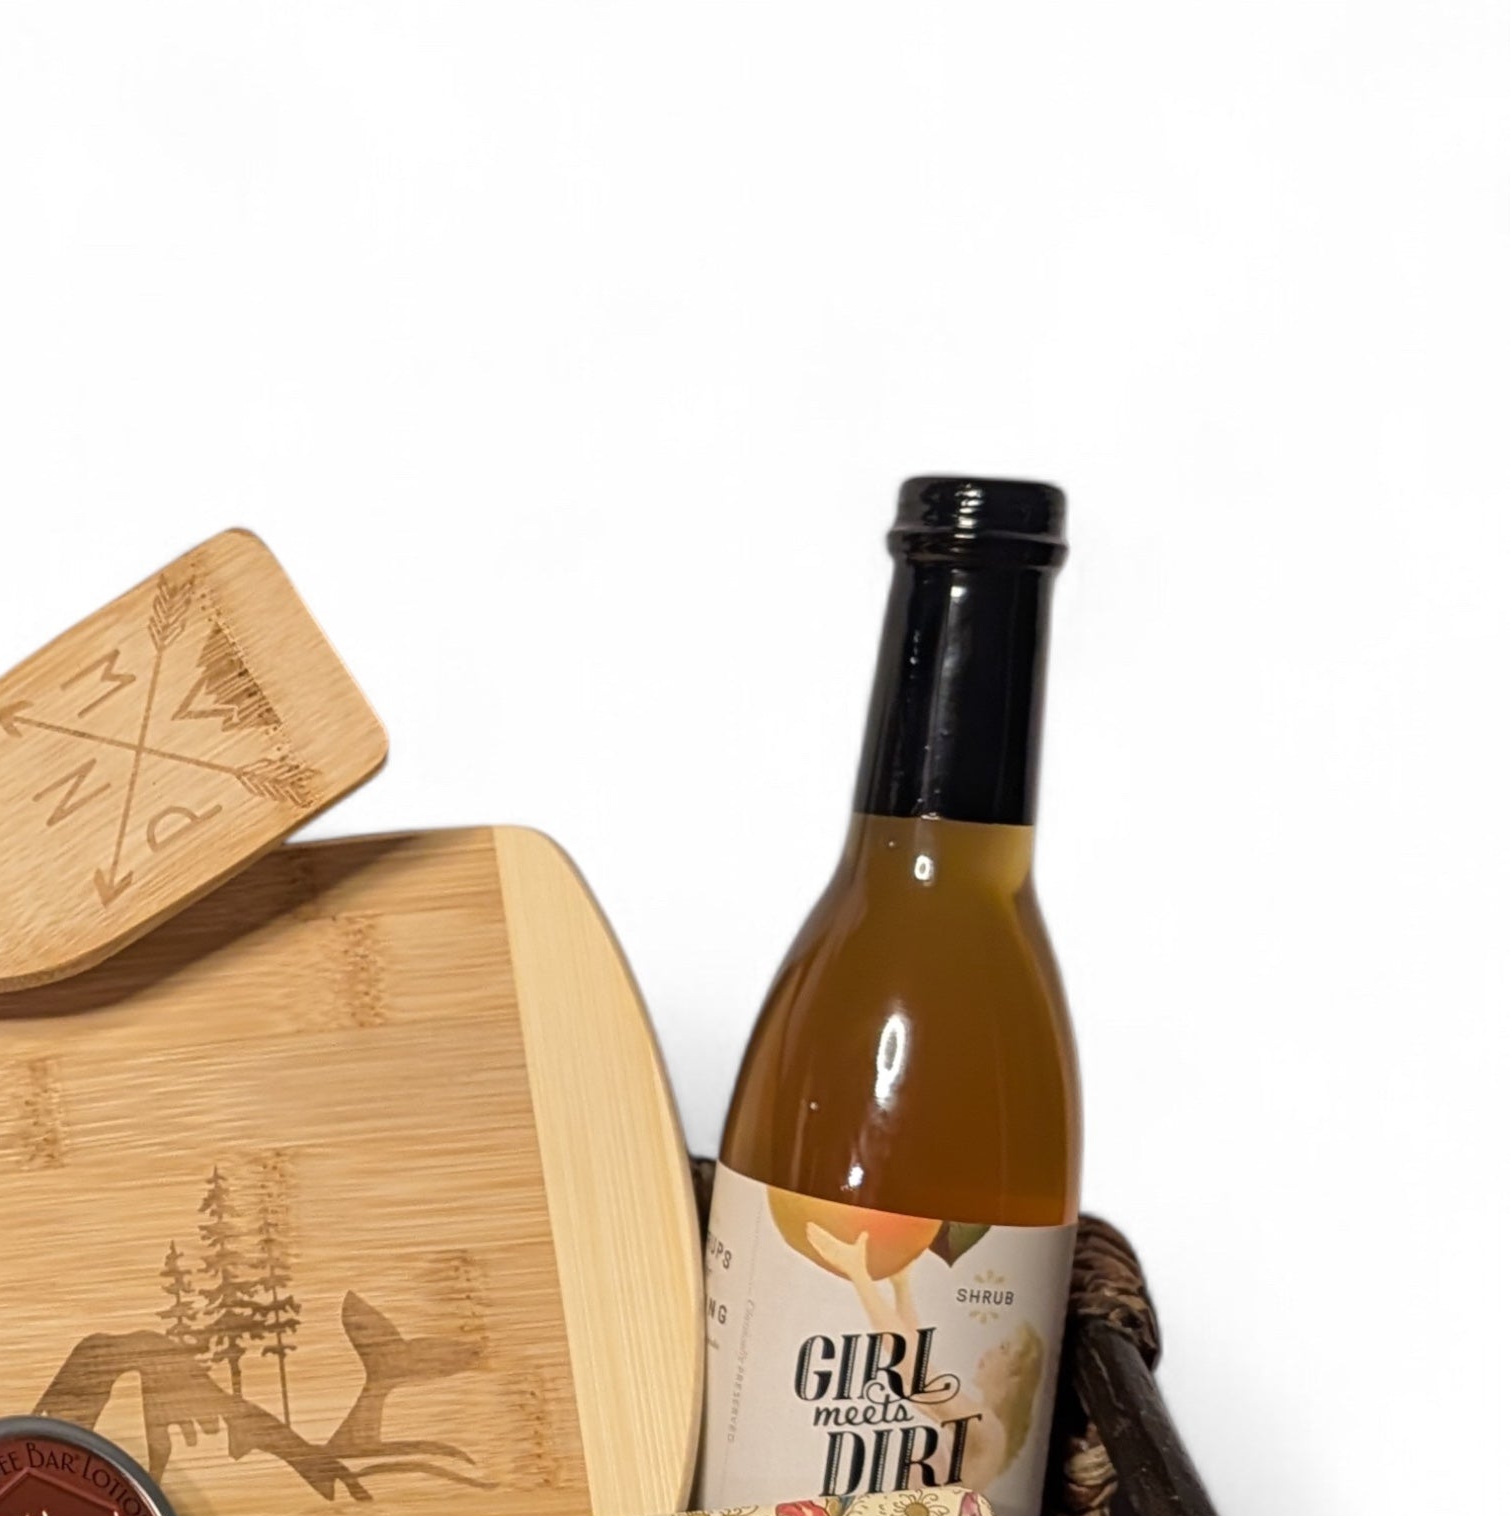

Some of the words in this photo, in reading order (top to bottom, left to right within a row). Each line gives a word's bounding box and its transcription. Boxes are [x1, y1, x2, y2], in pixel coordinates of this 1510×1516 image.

[956, 1287, 1015, 1306] SHRUB
[794, 1326, 961, 1405] GIRL
[812, 1393, 915, 1427] meets
[819, 1413, 983, 1497] DIRT
